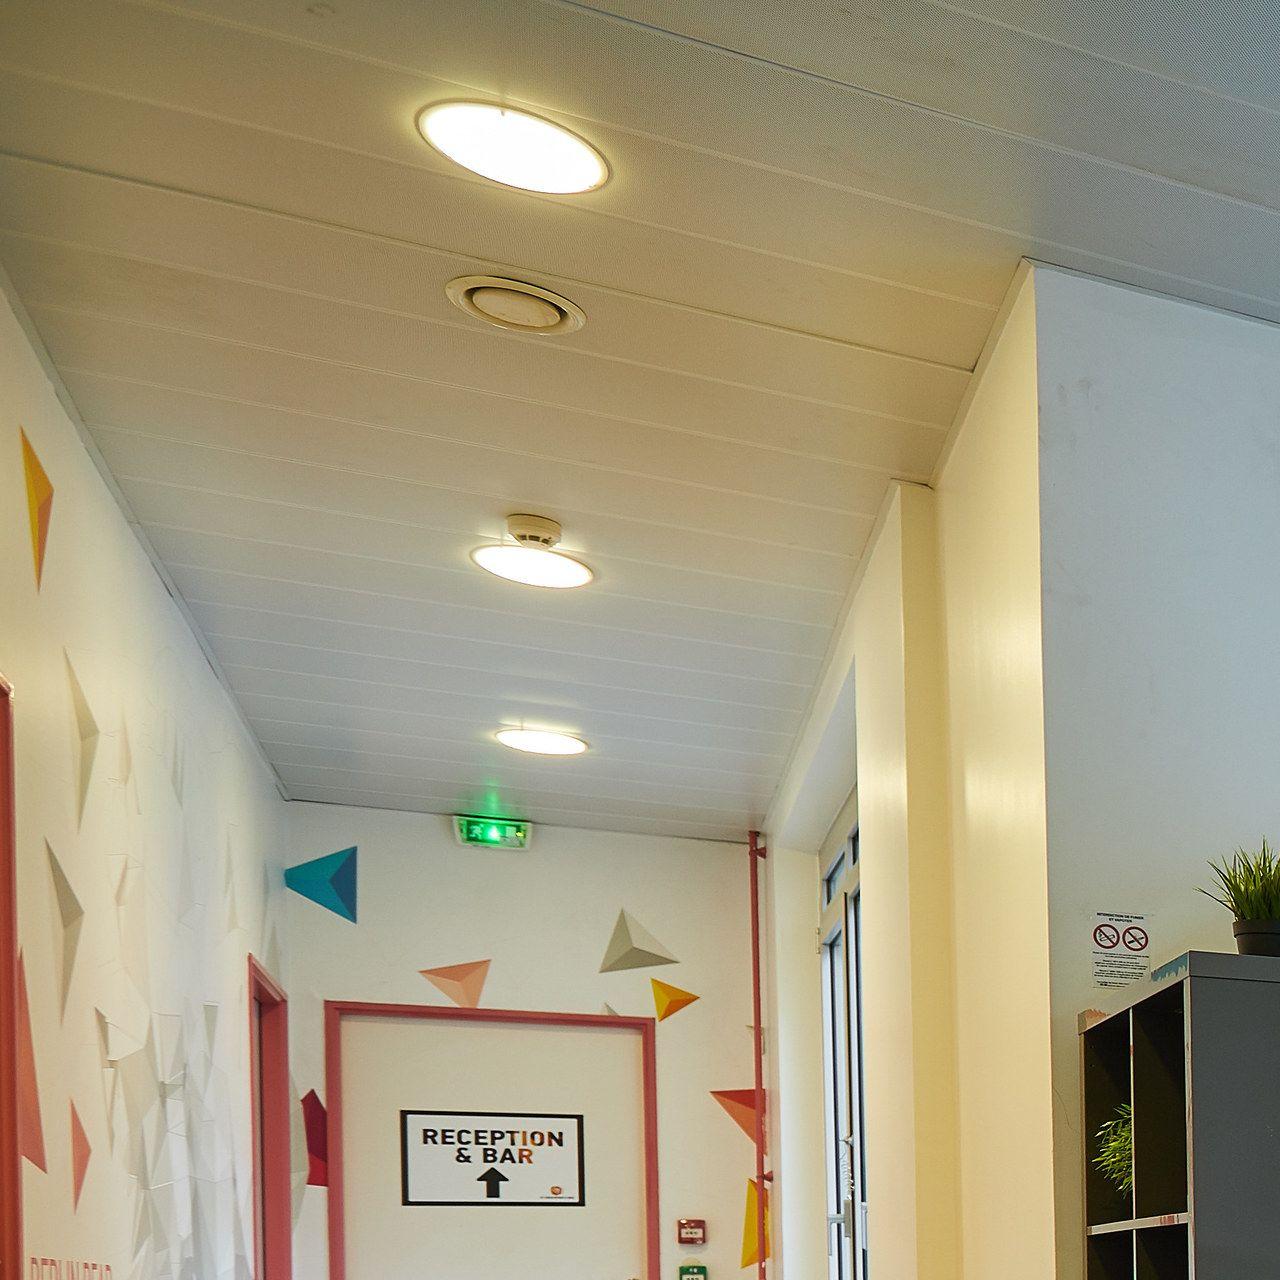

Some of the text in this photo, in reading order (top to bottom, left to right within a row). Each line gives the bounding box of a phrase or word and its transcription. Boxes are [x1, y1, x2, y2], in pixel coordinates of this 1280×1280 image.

[422, 1128, 564, 1147] RECEPTION
[455, 1147, 533, 1164] & BAR
